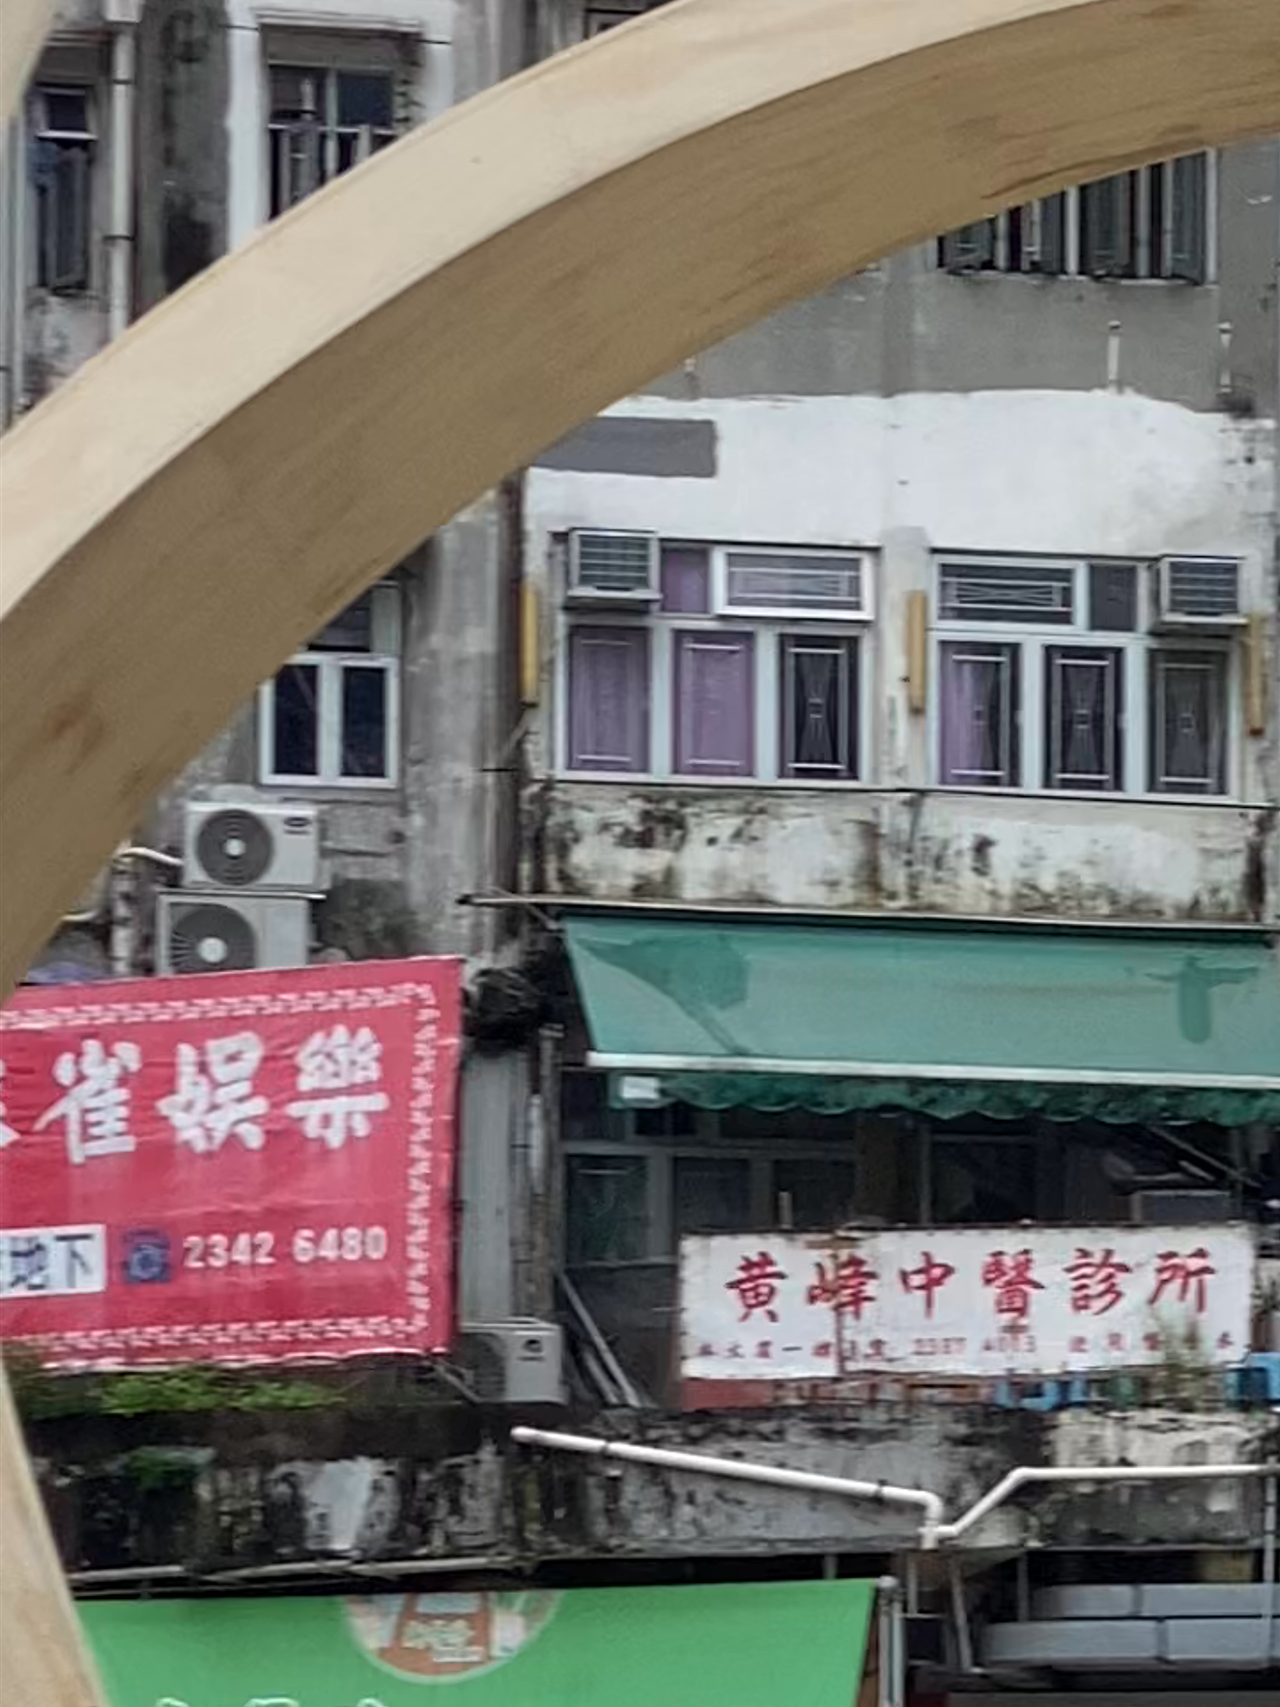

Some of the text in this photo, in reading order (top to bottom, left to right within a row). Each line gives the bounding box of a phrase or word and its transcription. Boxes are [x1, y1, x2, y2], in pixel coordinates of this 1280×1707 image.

[0, 1024, 390, 1165] 雀娛樂
[182, 1225, 389, 1269] 2342 6480
